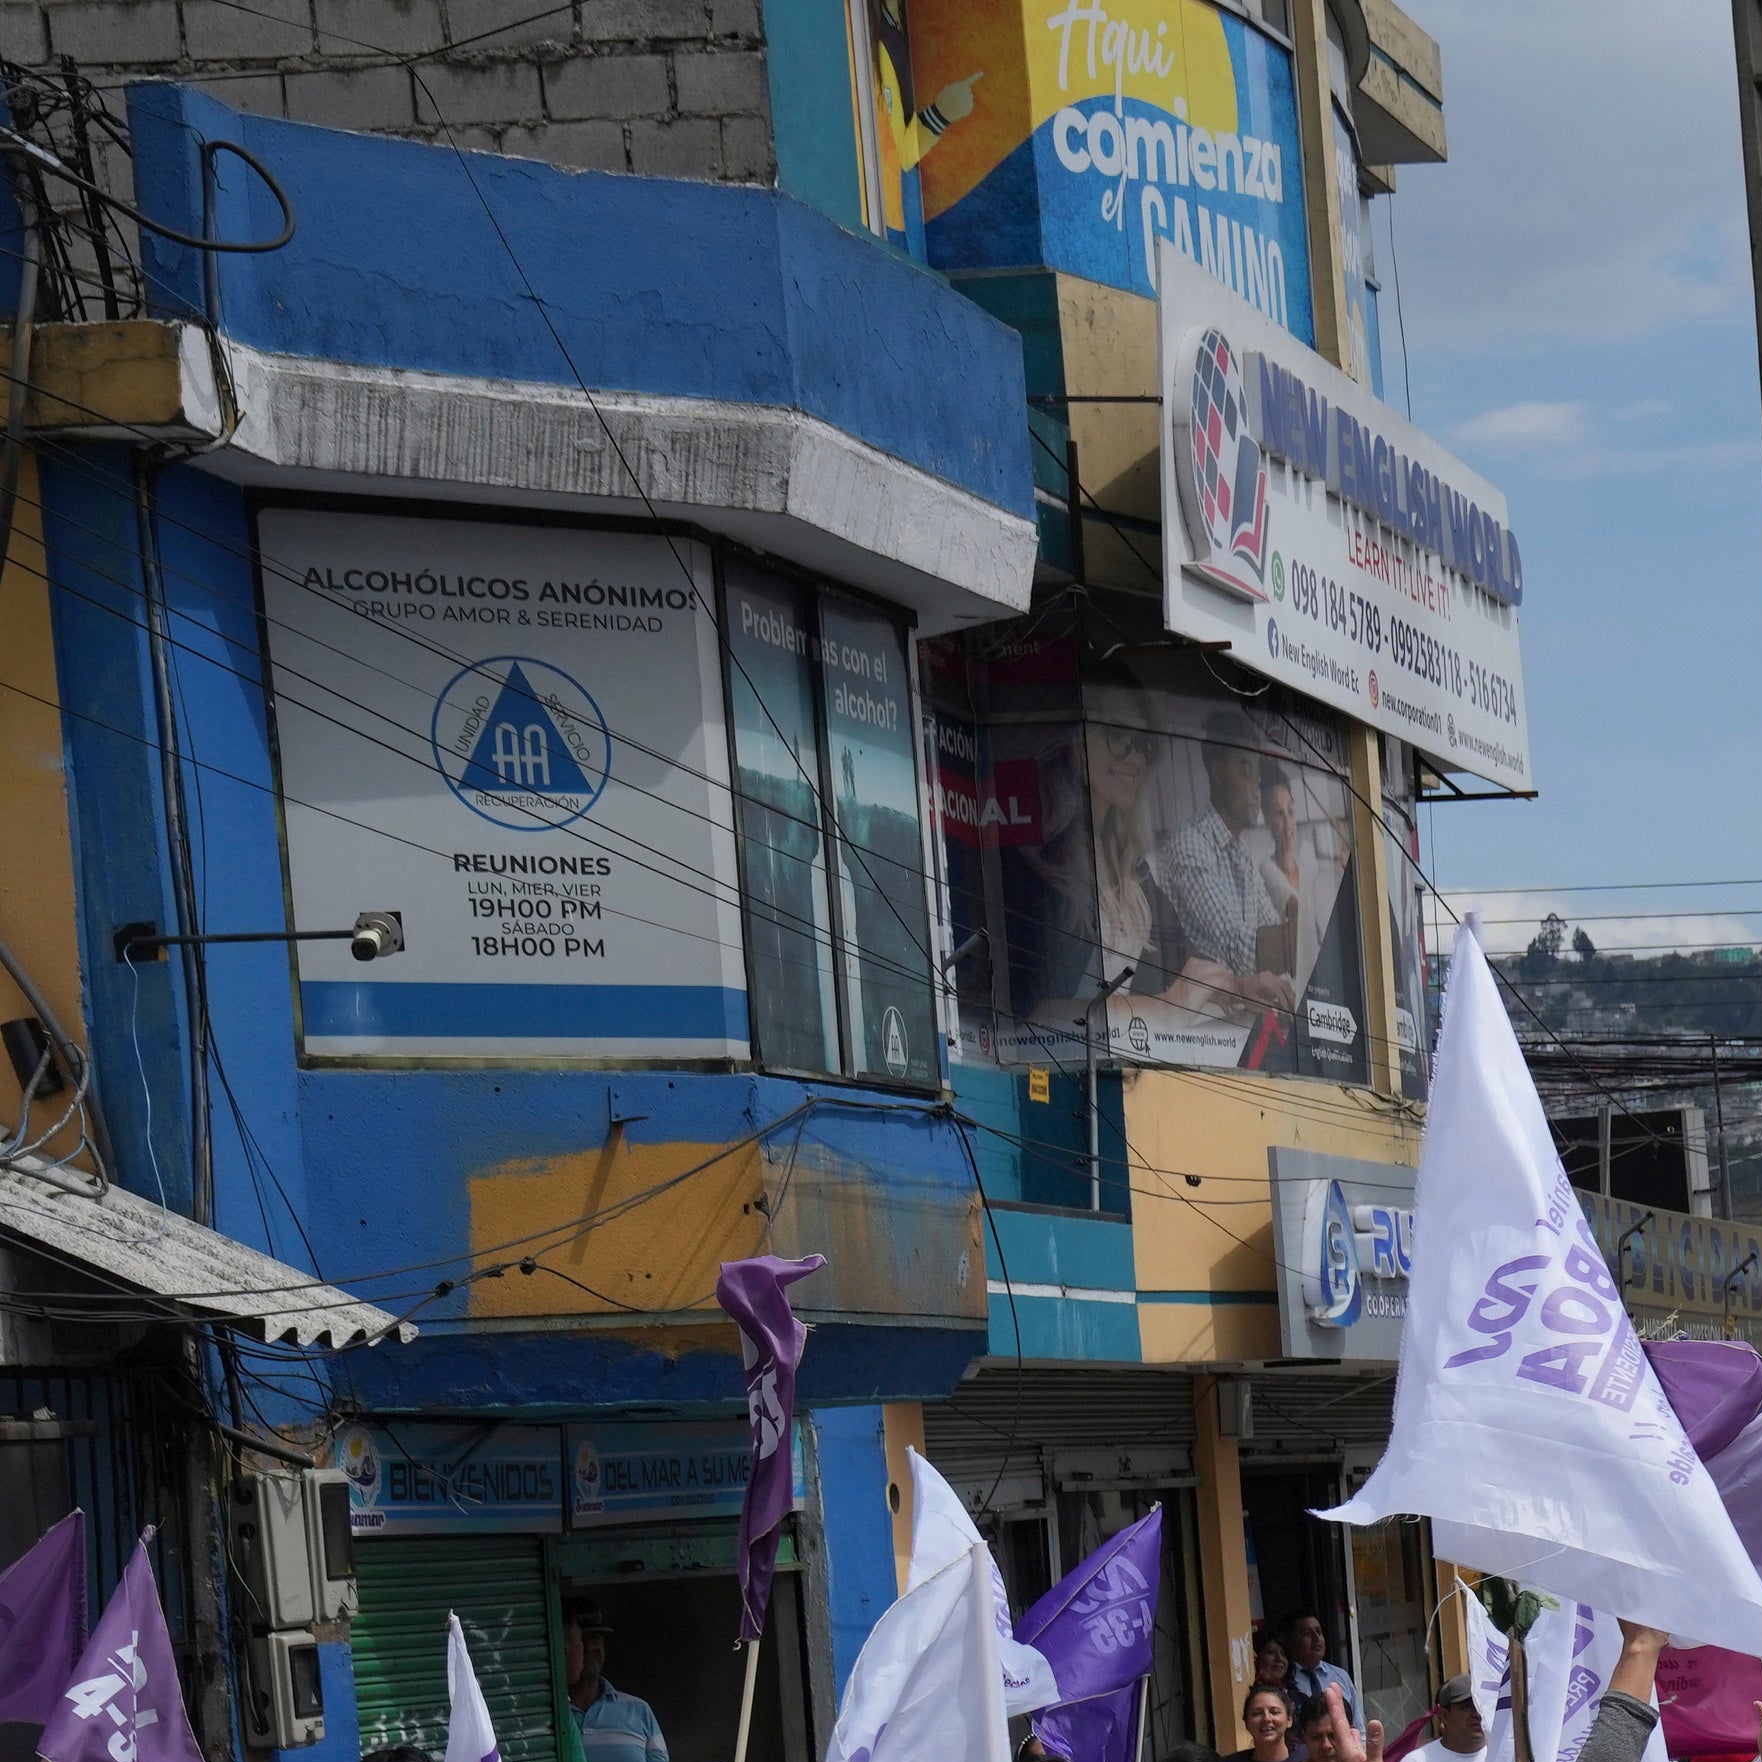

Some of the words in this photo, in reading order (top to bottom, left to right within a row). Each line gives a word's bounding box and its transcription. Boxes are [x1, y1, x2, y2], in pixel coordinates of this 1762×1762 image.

[1052, 96, 1283, 203] comienza
[1258, 352, 1328, 481] NEW
[1337, 411, 1447, 556] ENGLISH
[1450, 486, 1524, 608] WORLD
[302, 566, 530, 602] ALCOHÓLICOS
[537, 579, 698, 612] ANÓNIMOS
[1347, 527, 1390, 585] LEARN
[1410, 563, 1436, 613] LIVE
[353, 600, 436, 621] GRUPO
[443, 605, 511, 626] AMOR
[517, 610, 532, 626] &
[537, 611, 664, 634] SERENIDAD
[1291, 558, 1319, 621] 098
[1321, 576, 1347, 636] 184
[1350, 591, 1382, 654] 5789
[1390, 615, 1463, 699] 0992583118
[1469, 660, 1490, 713] 516
[1491, 672, 1518, 728] 6734
[842, 645, 871, 679] con
[873, 651, 888, 684] el
[1282, 634, 1300, 663] New
[1301, 644, 1329, 680] English
[1329, 657, 1351, 689] Word
[1351, 663, 1360, 695] Ec
[454, 694, 490, 753] UNIDAD
[545, 692, 591, 763] SERVICIO
[835, 682, 898, 733] alcohol?
[491, 722, 550, 786] AA
[475, 793, 580, 811] RECUPERACIÓN
[453, 853, 612, 876] REUNIONES
[467, 897, 552, 919] 19H00
[561, 899, 602, 920] PM
[468, 881, 508, 897] LUN,
[565, 882, 602, 898] VIER
[471, 935, 555, 958] 18H00
[565, 937, 606, 958] PM
[502, 920, 575, 936] SÁBADO
[1309, 1006, 1351, 1039] Cambridge
[389, 1462, 554, 1502] BIENVENIDOS
[605, 1461, 638, 1491] DEL
[641, 1459, 682, 1490] MAR
[685, 1459, 700, 1485] A
[703, 1457, 726, 1485] SU
